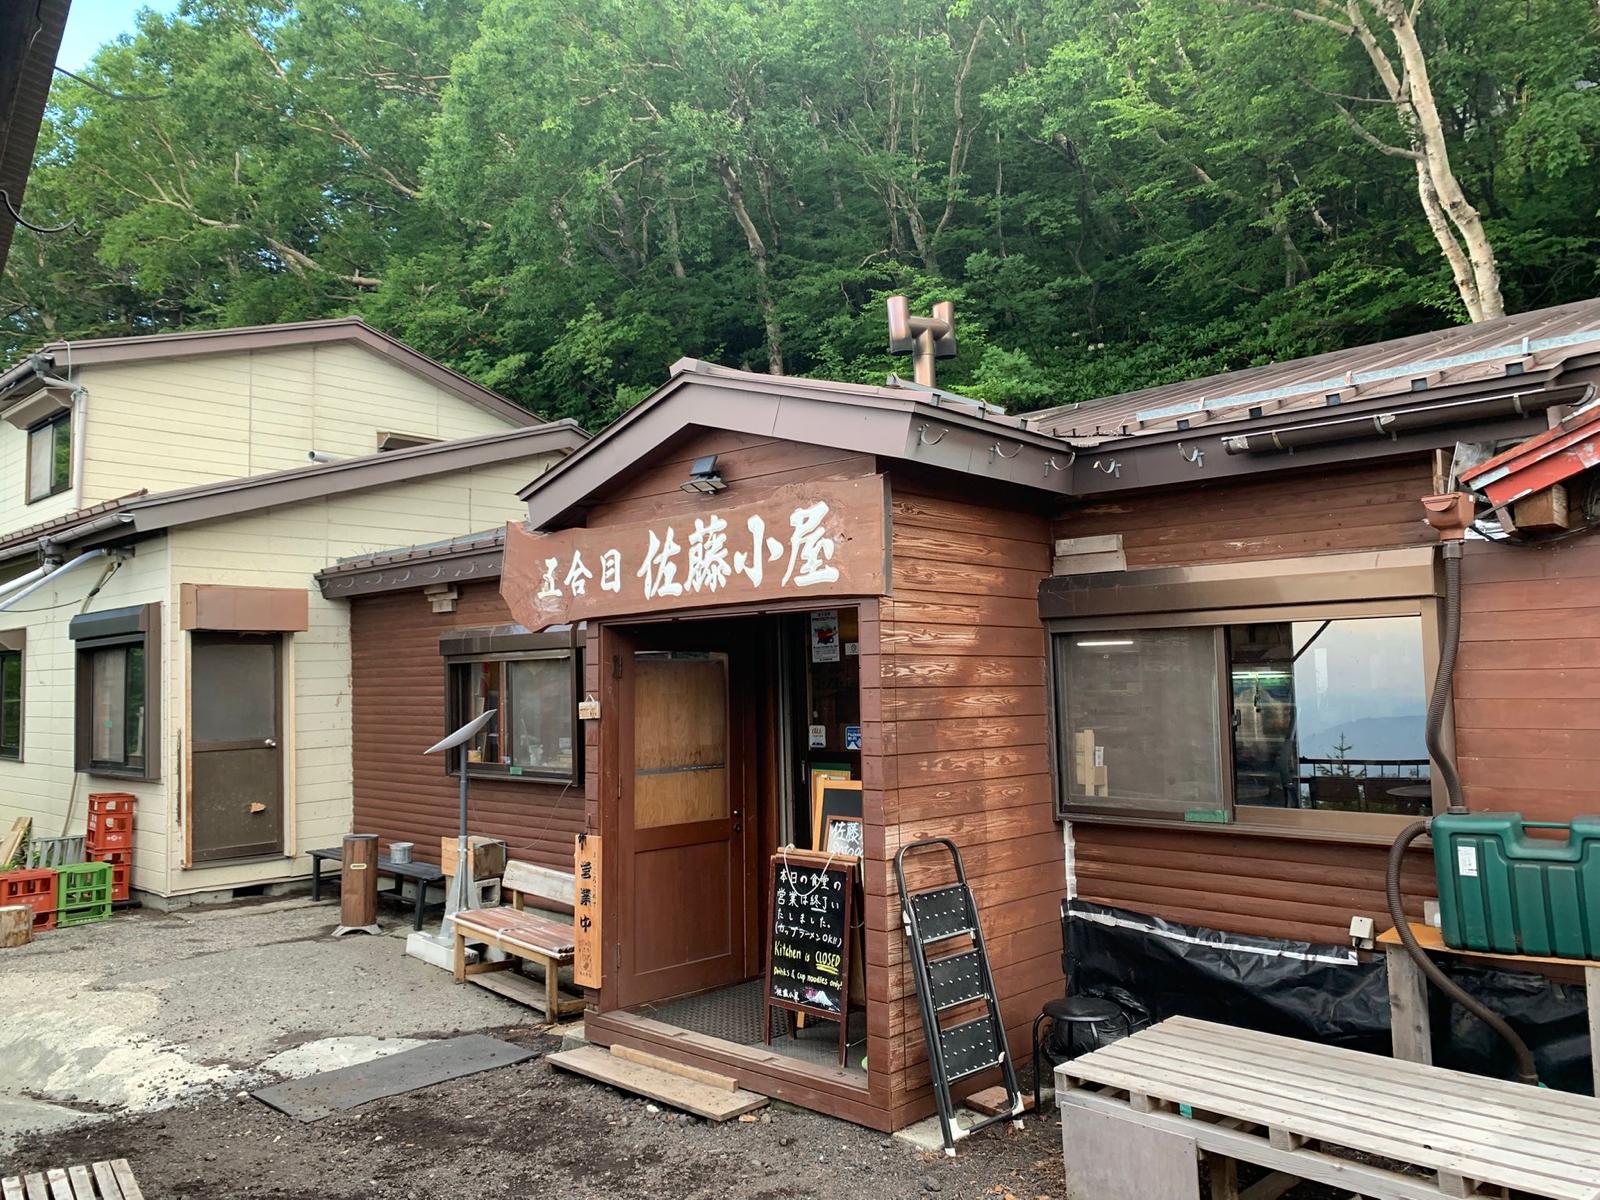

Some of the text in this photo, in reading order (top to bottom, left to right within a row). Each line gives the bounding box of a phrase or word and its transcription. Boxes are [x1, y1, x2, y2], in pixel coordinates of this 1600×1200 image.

[538, 501, 839, 600] 五合目 佐藤小屋
[780, 868, 842, 891] 本日の食堂の
[777, 888, 839, 910] 営業は終了い
[774, 940, 802, 960] Kitchen
[815, 951, 841, 968] CLOSED
[773, 966, 790, 977] Drinks
[791, 969, 796, 980] &
[807, 975, 828, 986] noodles
